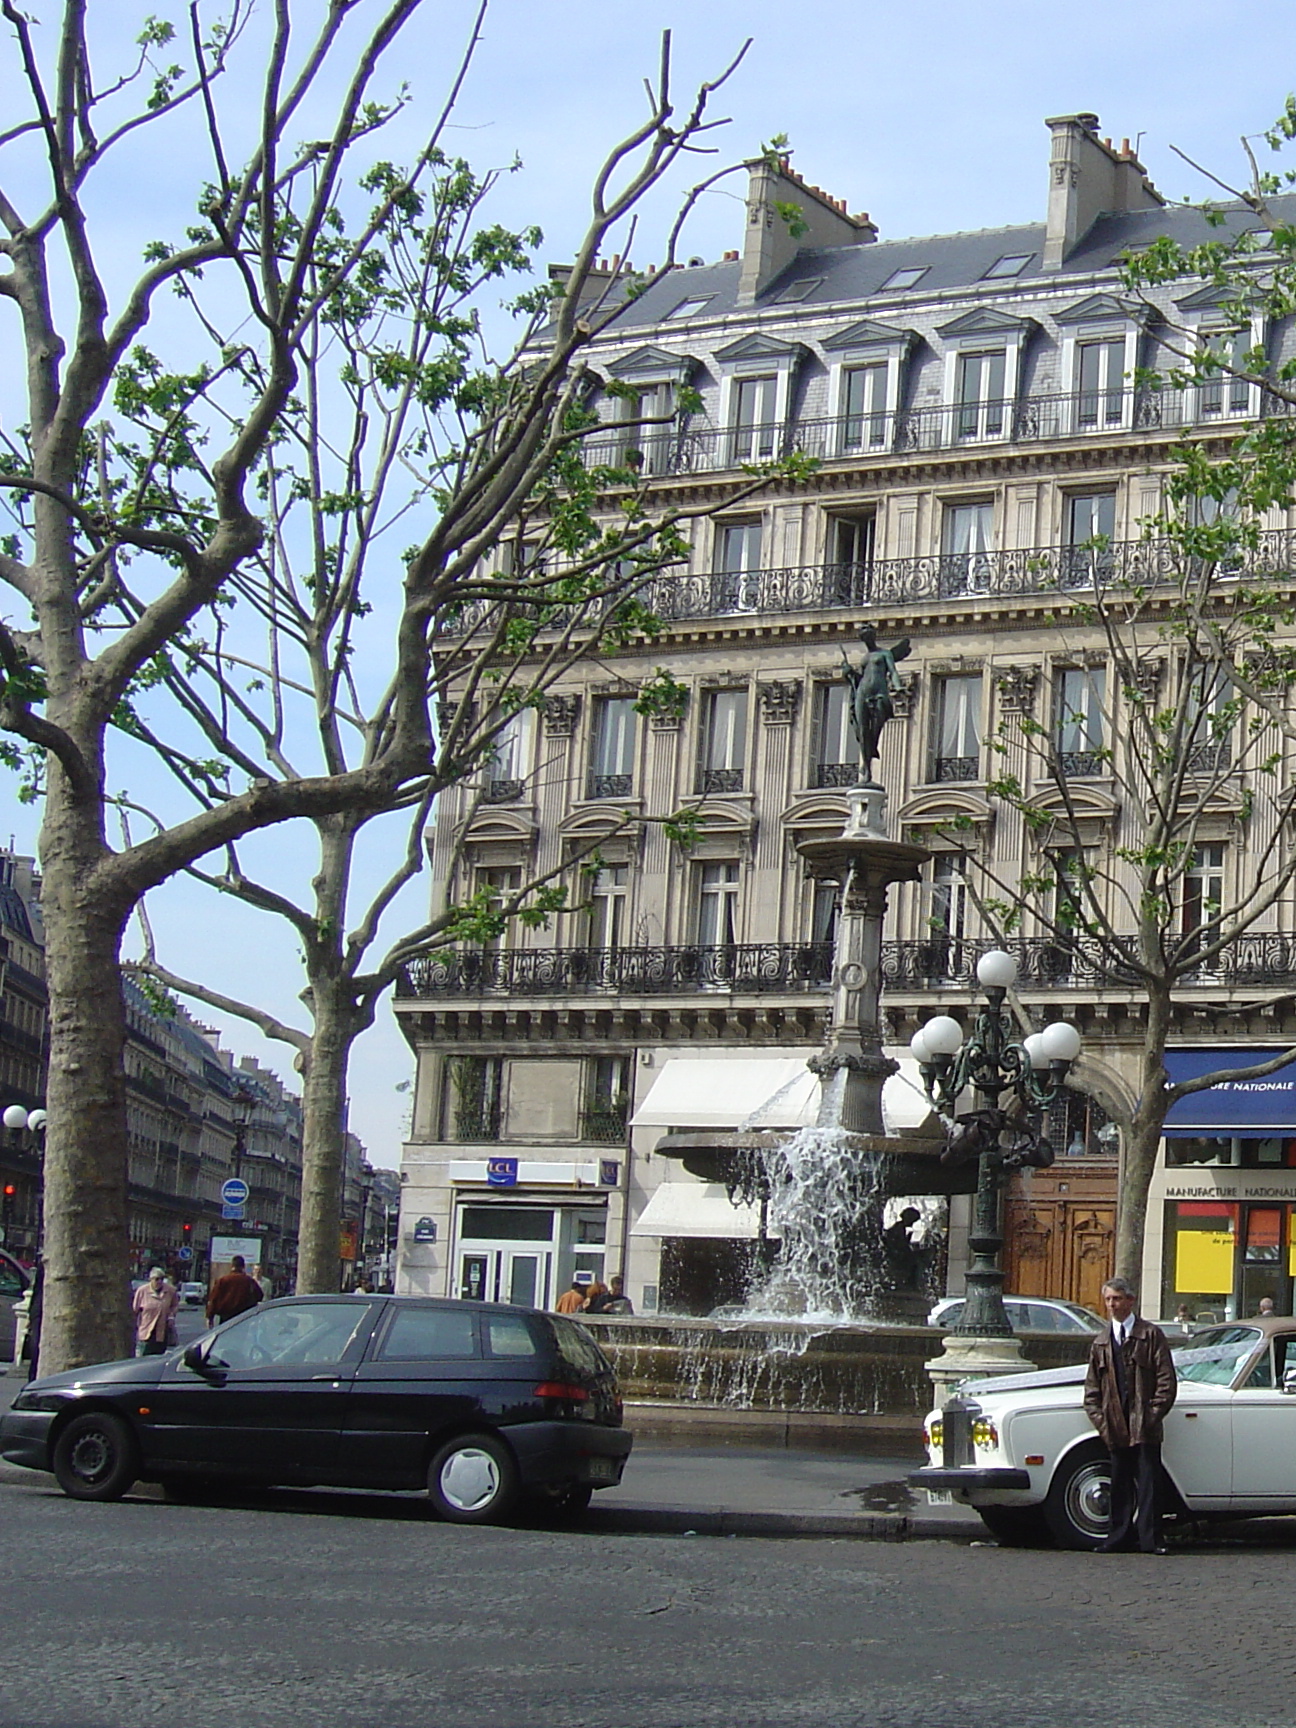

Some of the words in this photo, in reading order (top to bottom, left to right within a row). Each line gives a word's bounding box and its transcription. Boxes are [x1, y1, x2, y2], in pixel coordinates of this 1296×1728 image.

[1233, 1082, 1293, 1092] NATIONALE
[488, 1162, 513, 1173] LCL
[1166, 1187, 1237, 1198] MANUFACTURE
